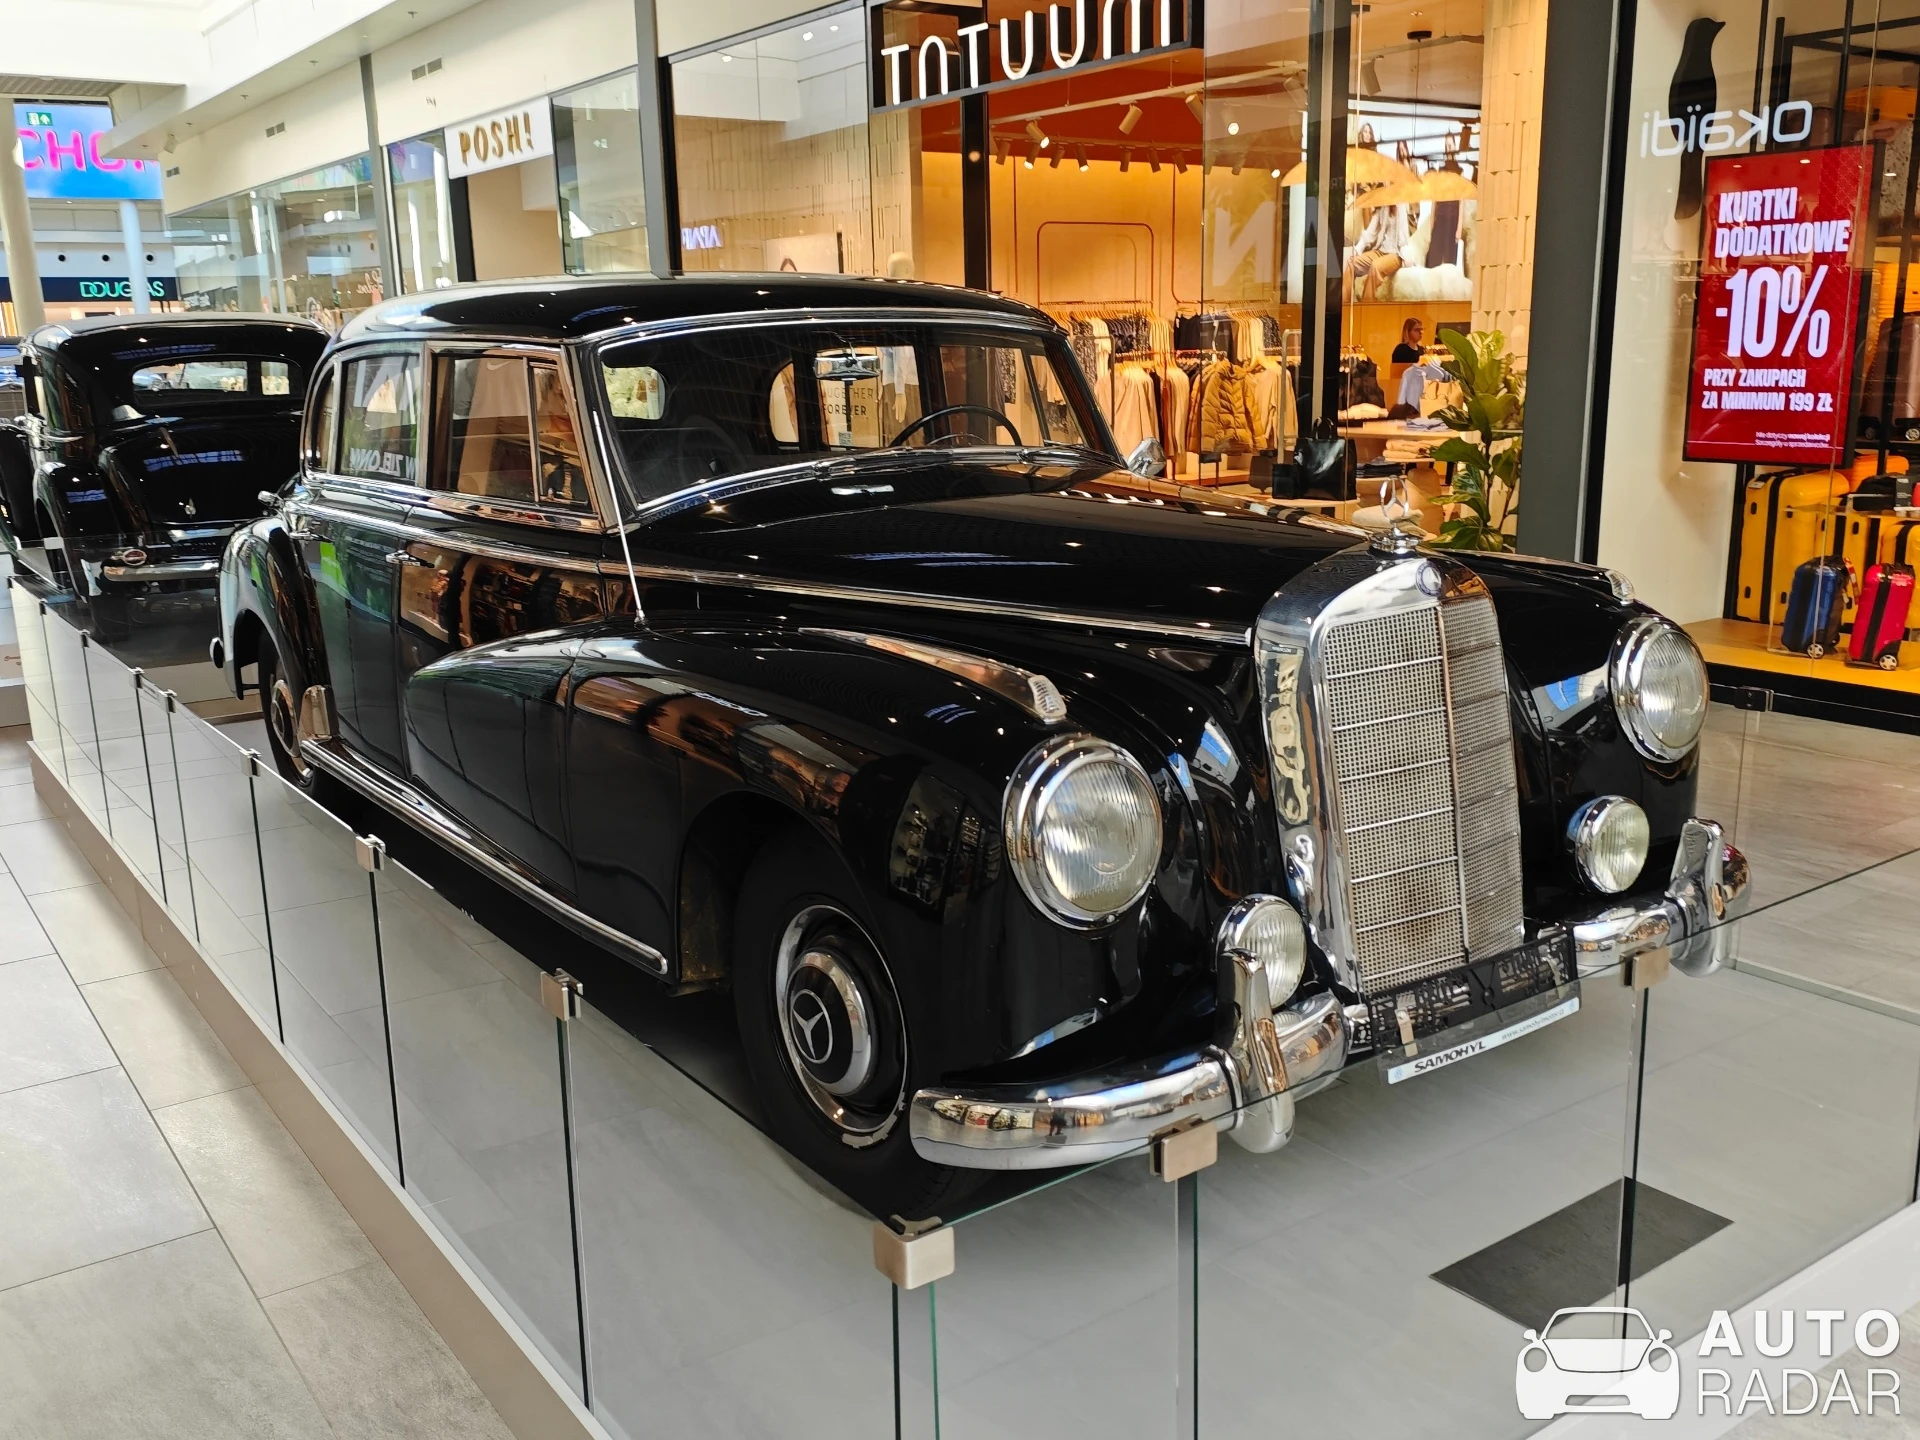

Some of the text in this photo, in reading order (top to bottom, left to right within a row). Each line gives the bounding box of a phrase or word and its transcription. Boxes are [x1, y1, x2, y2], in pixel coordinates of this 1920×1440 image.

[881, 0, 1171, 105] TATUUM
[458, 111, 535, 166] POSH!
[1718, 186, 1798, 223] KURTKI
[1714, 219, 1851, 258] DODATKOWE
[1715, 264, 1831, 358] -10%
[1703, 368, 1806, 388] PRZY ZAKUPACH
[823, 404, 867, 416] FOREER
[1701, 391, 1833, 412] ZA MINIMUM 199 ZŁ
[1414, 1040, 1487, 1073] SAMOHYL
